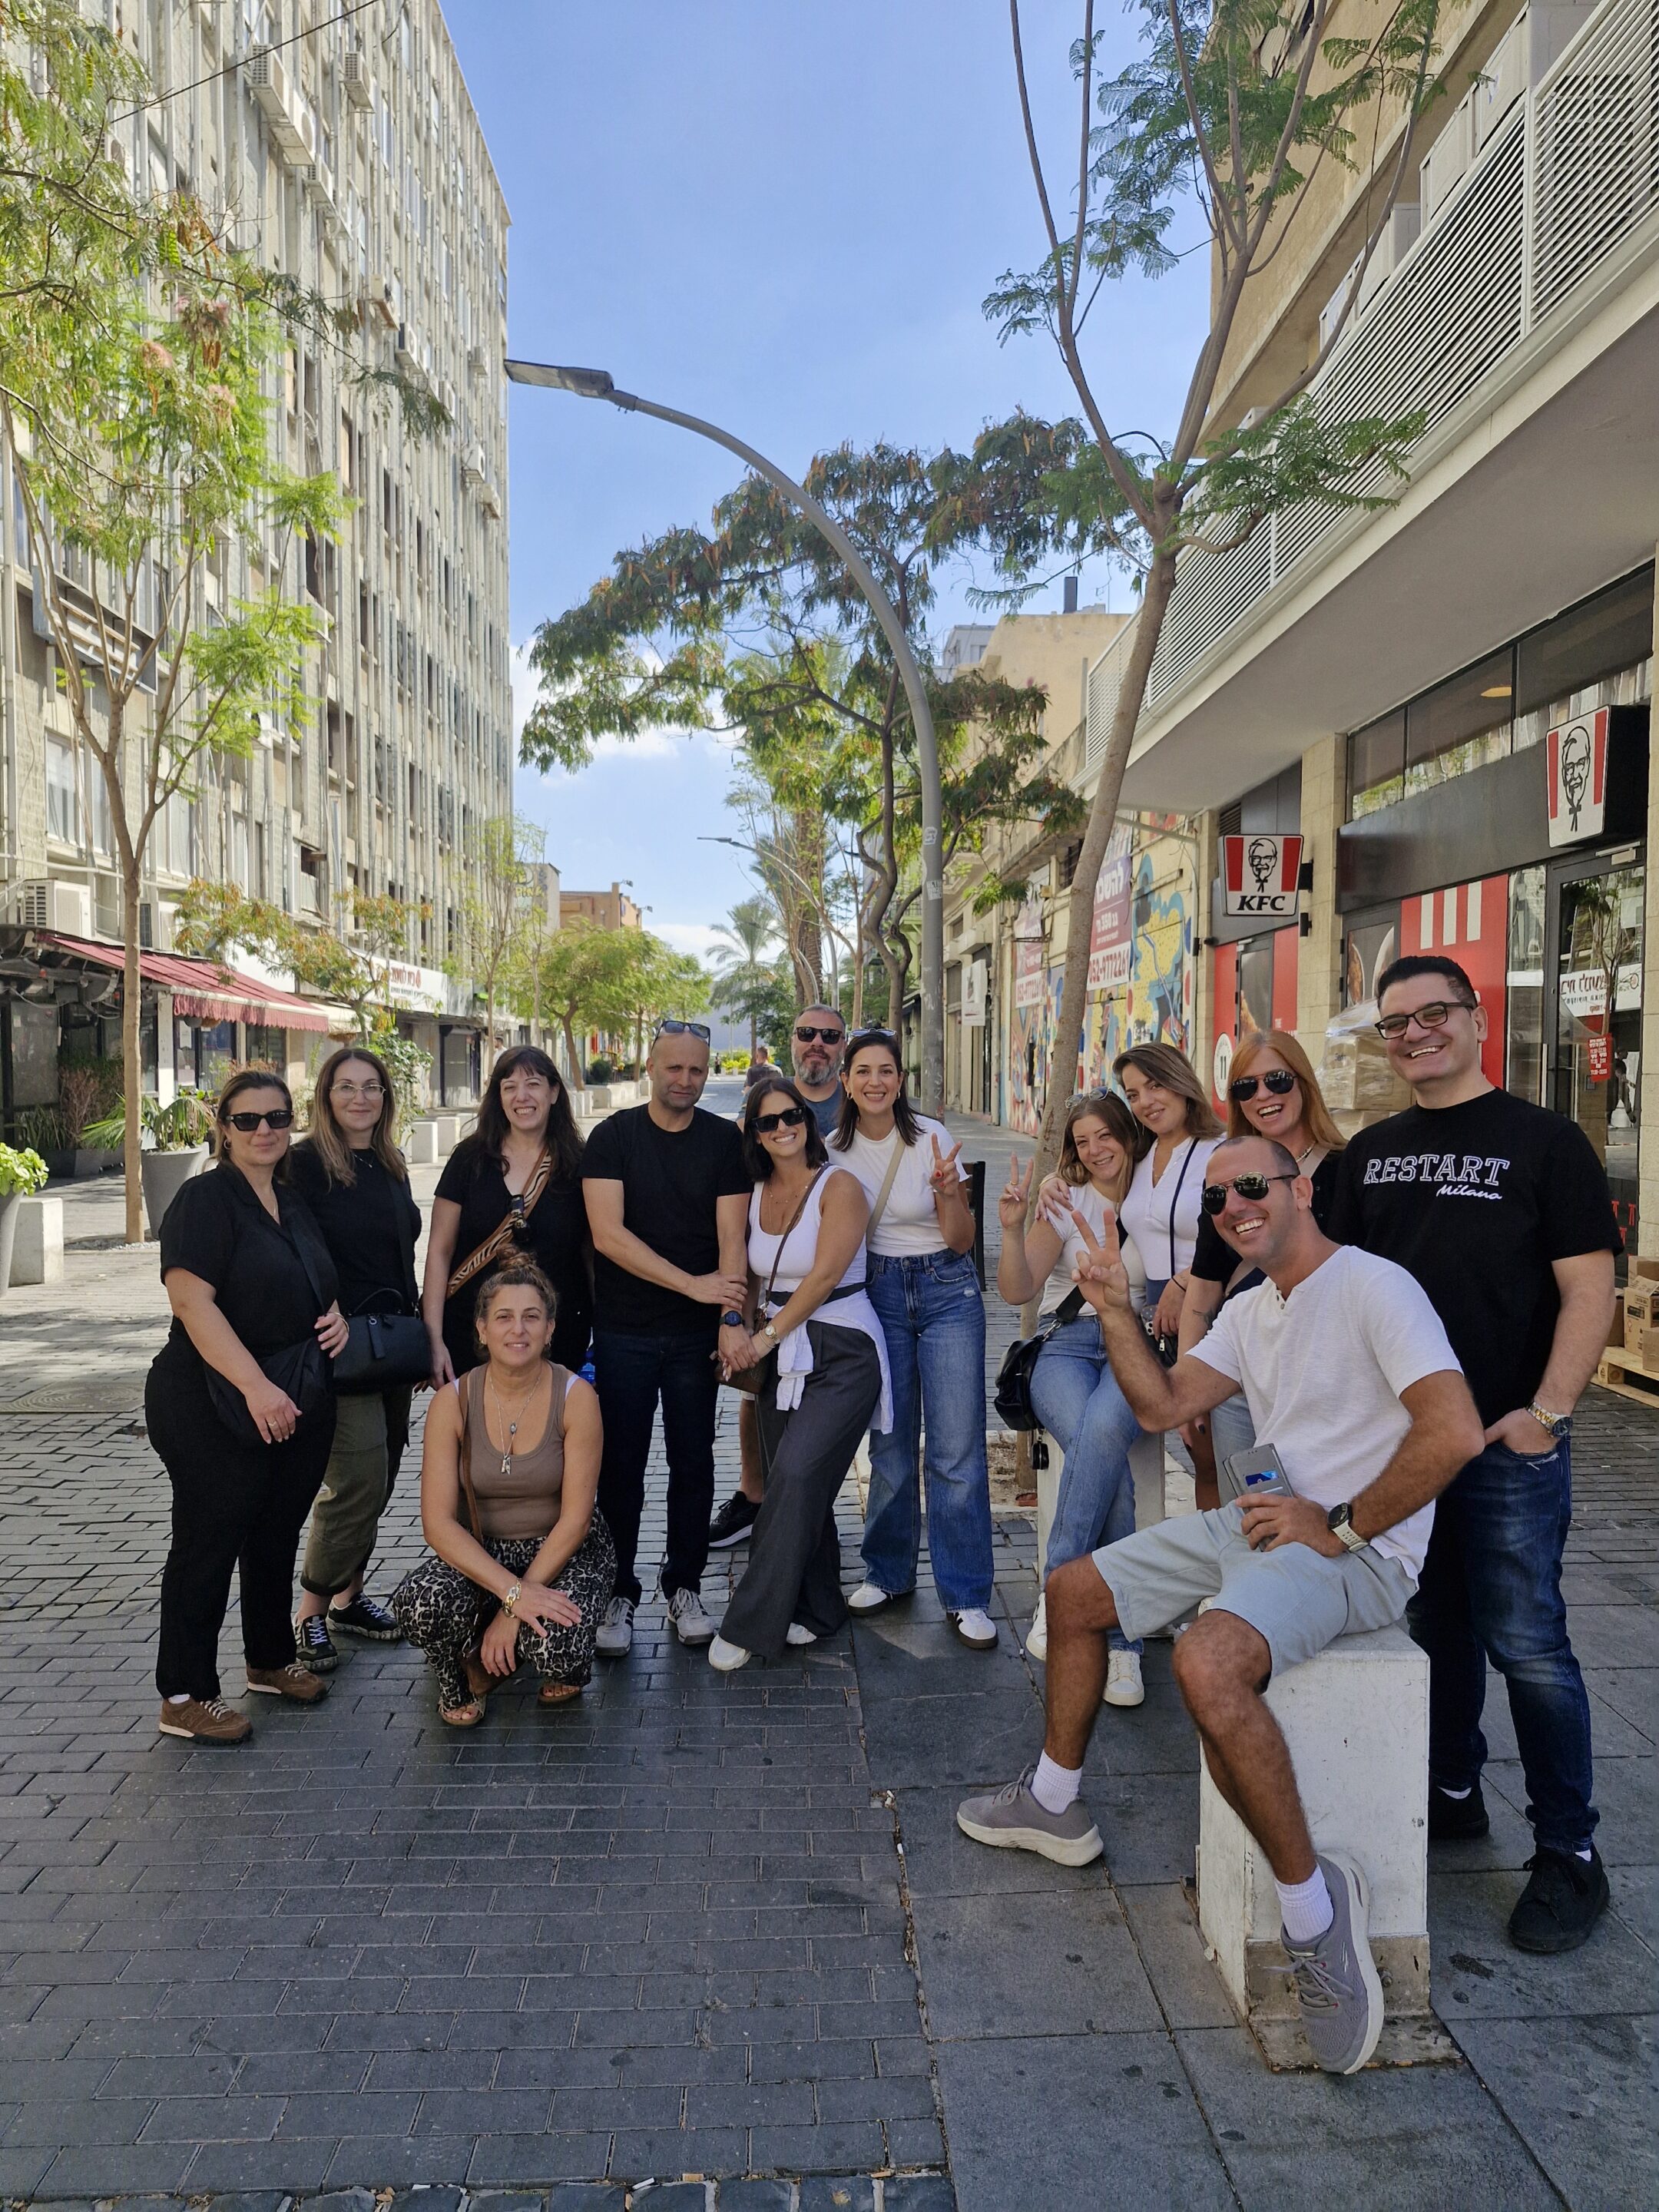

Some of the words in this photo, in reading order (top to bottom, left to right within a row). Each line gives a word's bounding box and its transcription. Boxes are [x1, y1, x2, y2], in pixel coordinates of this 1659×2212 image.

[1237, 896, 1285, 911] KFC
[1363, 1154, 1510, 1186] RESTART
[1436, 1184, 1502, 1200] Milano
